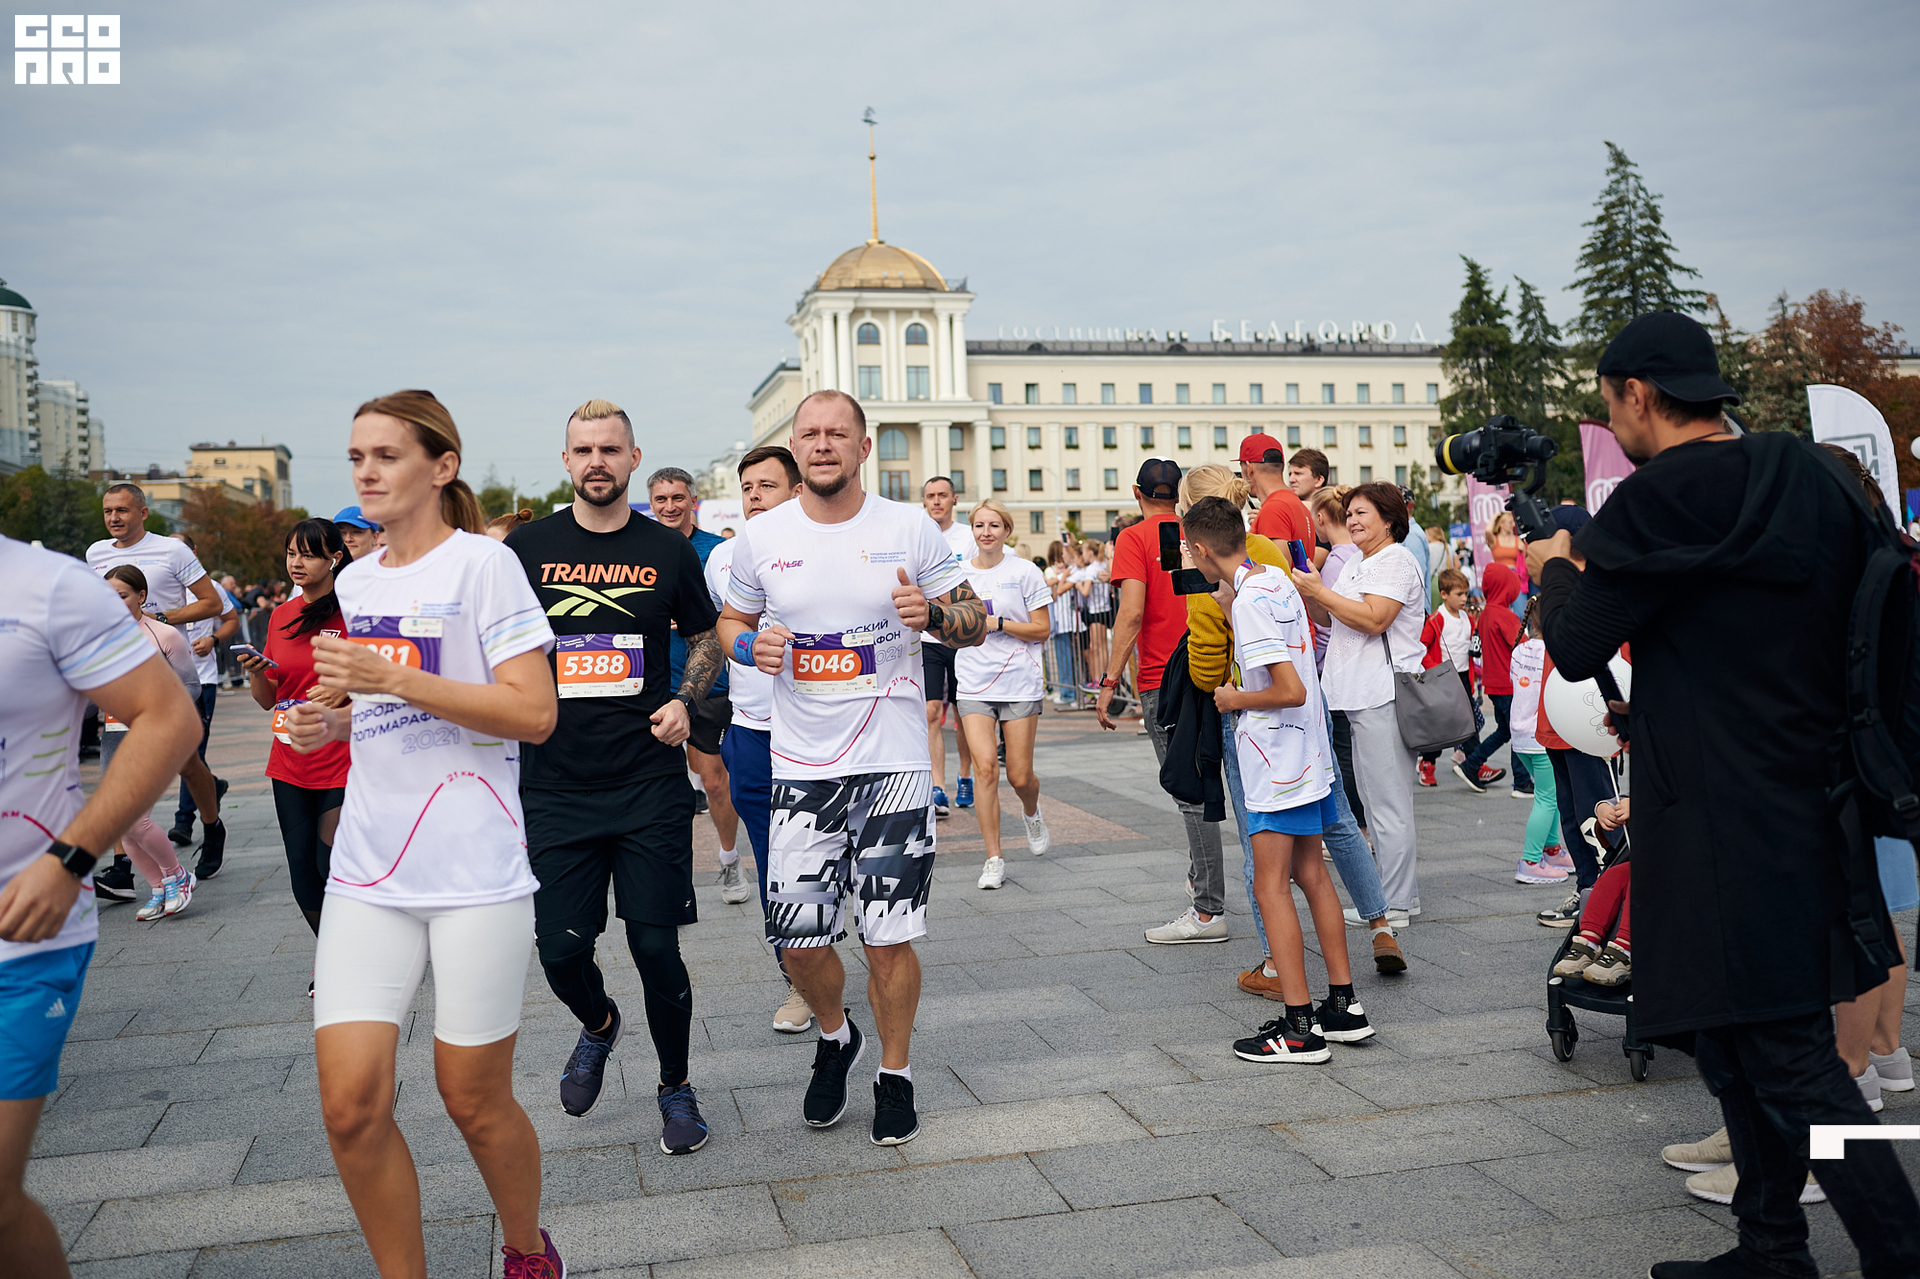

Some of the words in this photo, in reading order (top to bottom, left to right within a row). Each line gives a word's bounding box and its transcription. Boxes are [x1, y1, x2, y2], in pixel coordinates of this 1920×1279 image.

[1211, 319, 1427, 343] БЕЛГОРОД
[540, 563, 658, 586] TRAINING
[563, 654, 625, 676] 5388
[796, 652, 855, 674] 5046
[875, 644, 903, 666] 021
[401, 726, 461, 755] 2021
